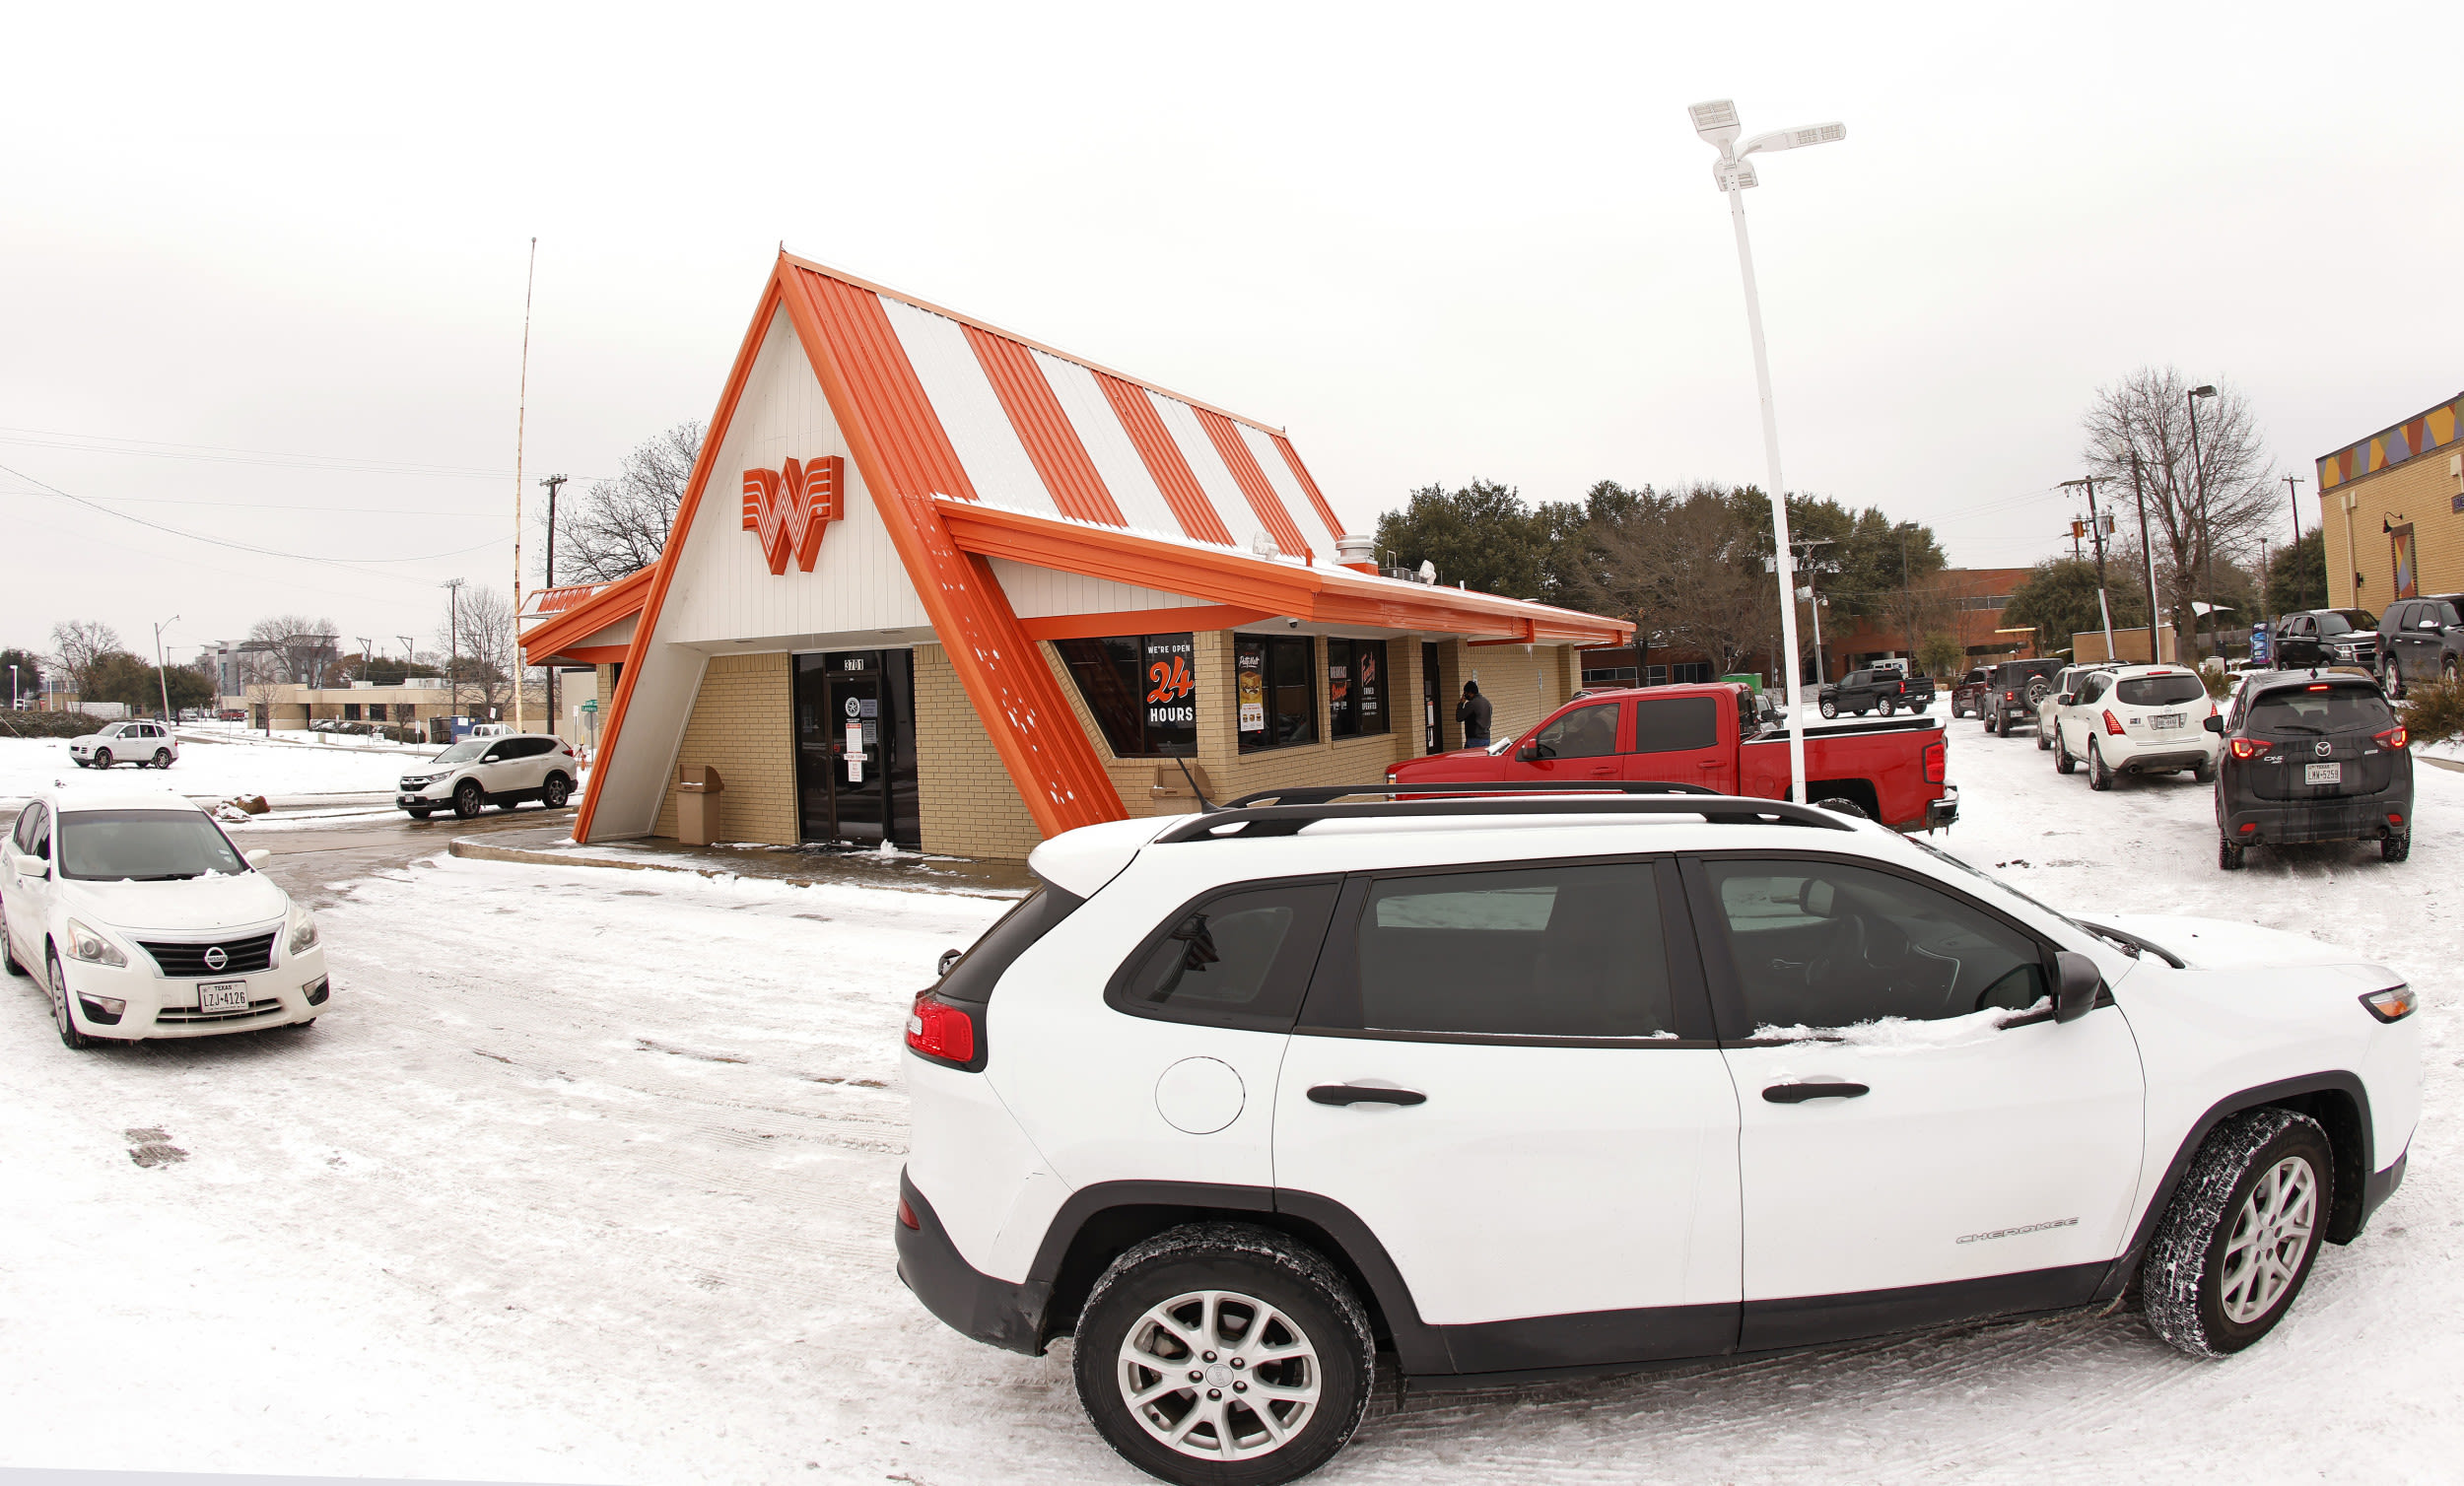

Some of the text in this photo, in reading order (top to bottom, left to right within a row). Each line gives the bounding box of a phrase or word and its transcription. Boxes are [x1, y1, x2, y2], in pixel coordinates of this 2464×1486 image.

[741, 455, 844, 575] W
[1148, 643, 1191, 654] WE'RE OPEN
[845, 659, 863, 670] 3701
[1146, 655, 1196, 704] 24
[1149, 707, 1194, 722] HOURS
[1955, 1217, 2079, 1244] CHEROKEE
